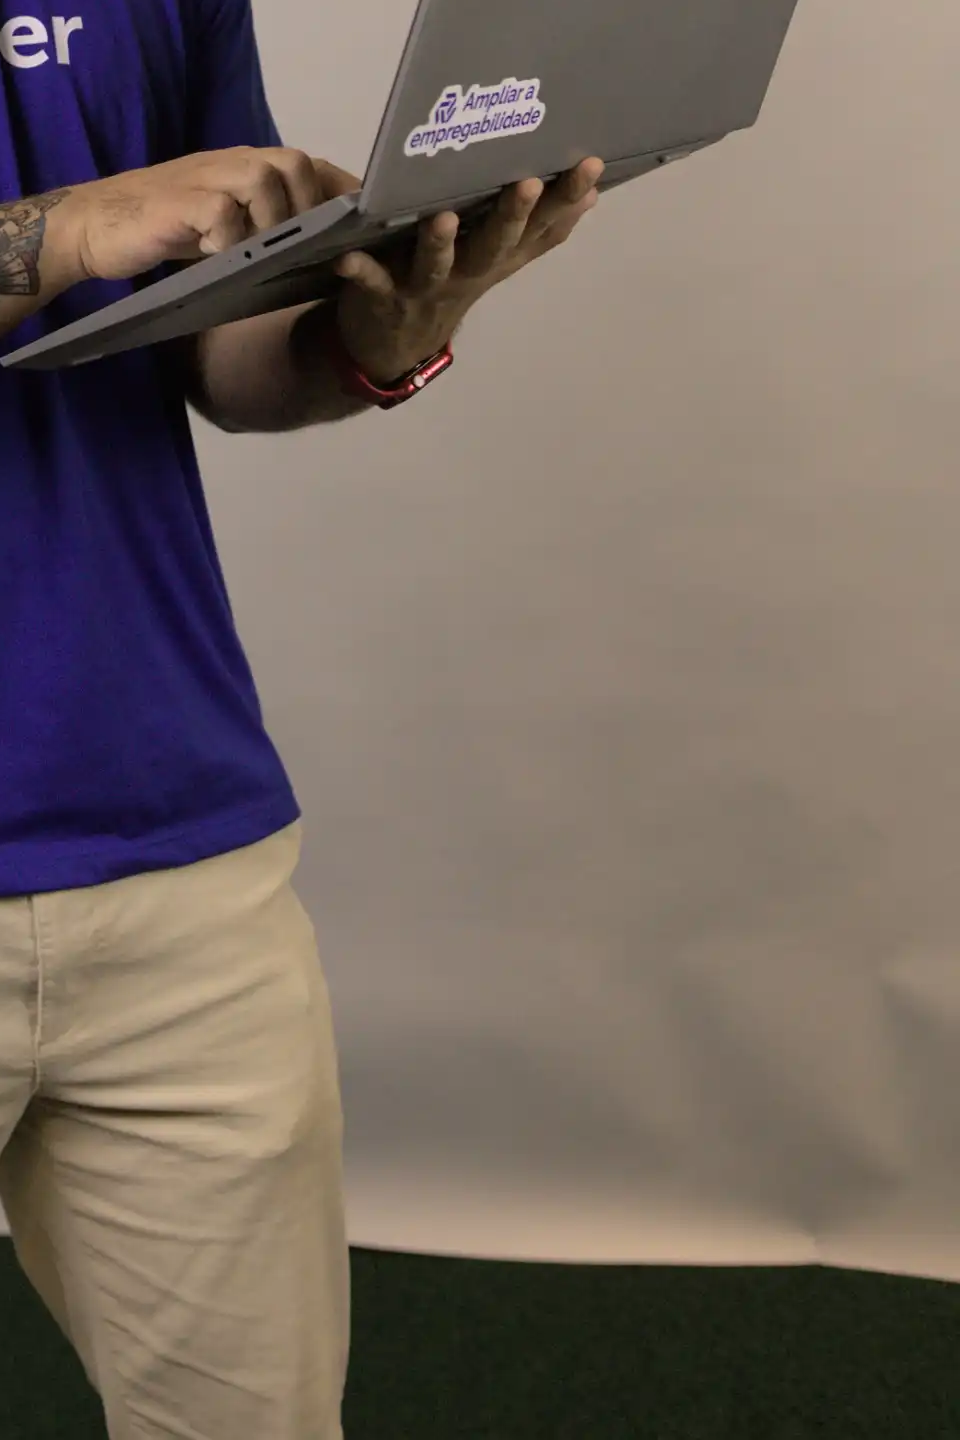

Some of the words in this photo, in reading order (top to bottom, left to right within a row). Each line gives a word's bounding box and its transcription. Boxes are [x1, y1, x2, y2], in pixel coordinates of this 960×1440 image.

[462, 85, 524, 112] Ampliar
[524, 85, 536, 100] a
[409, 106, 542, 149] empregabilidade
